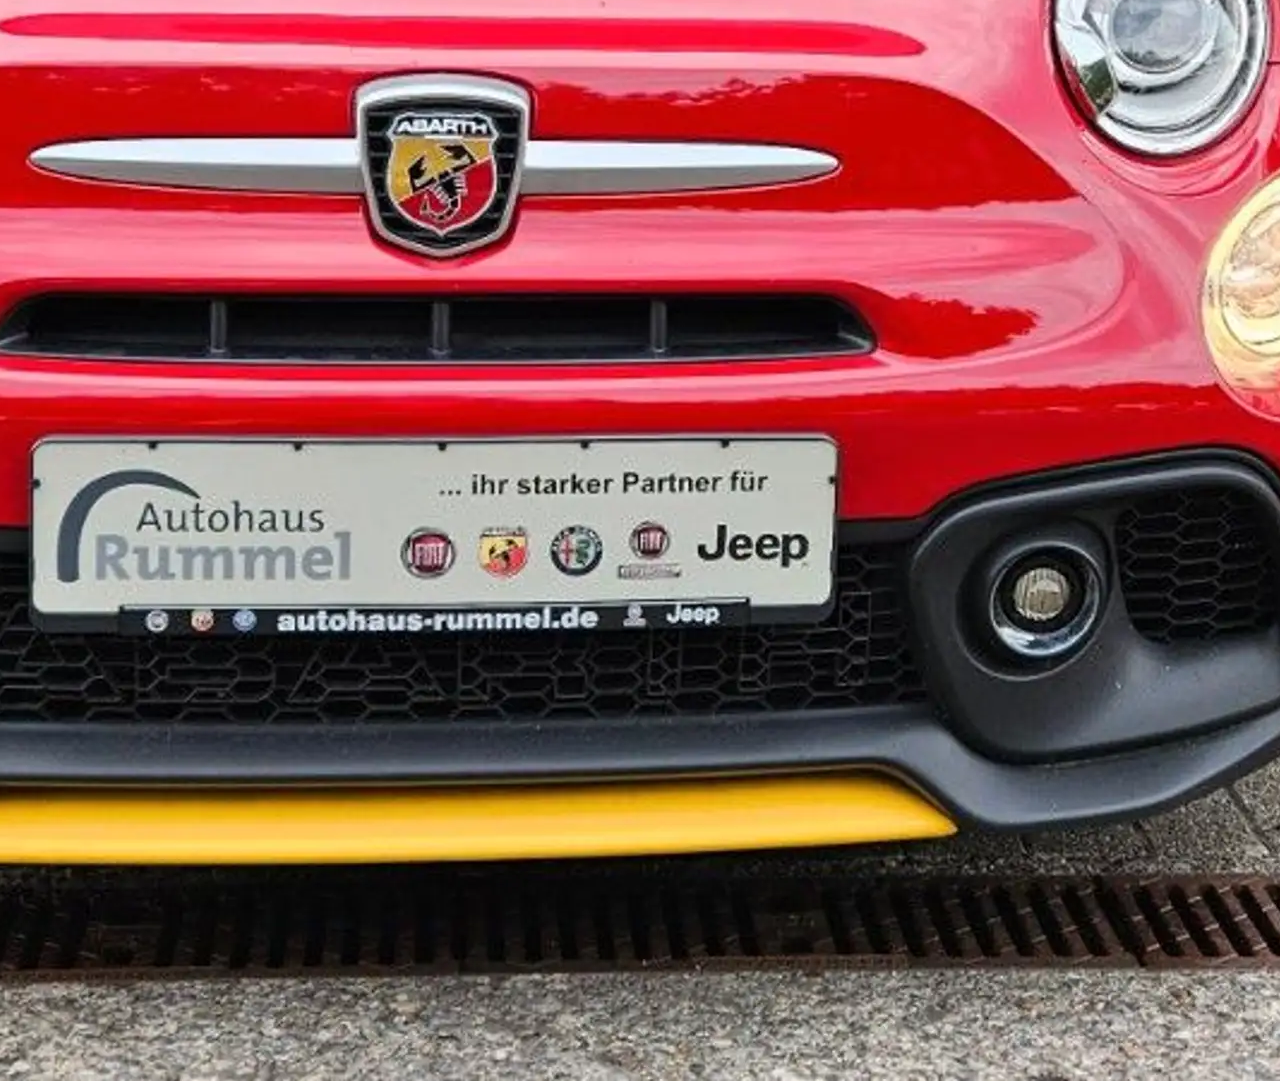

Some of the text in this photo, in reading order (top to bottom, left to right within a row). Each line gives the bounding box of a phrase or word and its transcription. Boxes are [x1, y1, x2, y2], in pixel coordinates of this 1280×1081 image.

[398, 118, 488, 135] ABARTH
[472, 473, 509, 495] ihr
[517, 473, 615, 495] starker
[622, 471, 722, 494] Partner
[730, 469, 769, 492] für
[136, 500, 326, 533] Autohaus
[95, 531, 353, 581] Rummel
[696, 524, 811, 568] Jeep
[277, 606, 599, 632] autohaus-rummel.de
[666, 603, 721, 625] Jeep
